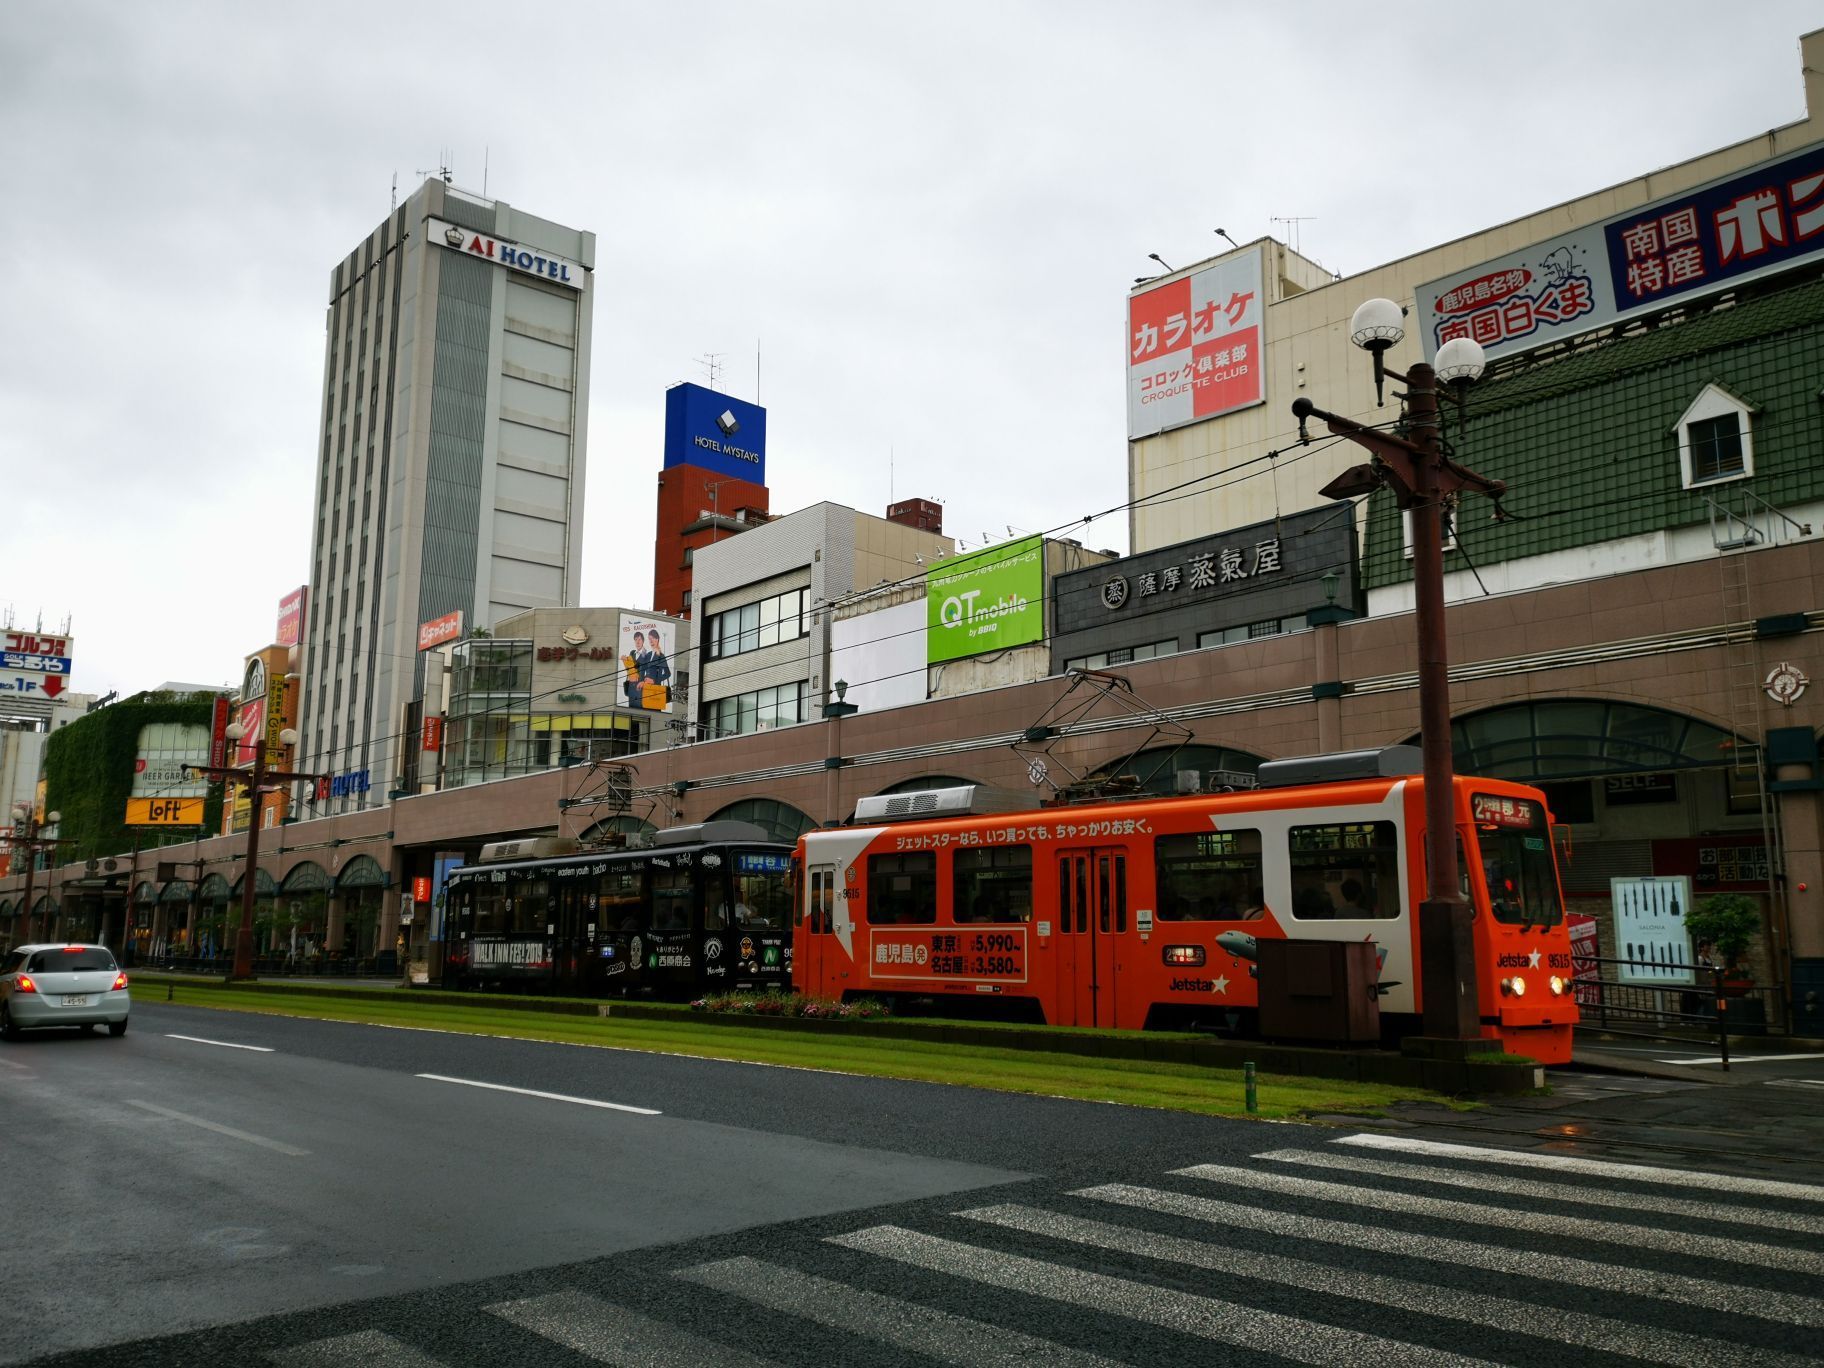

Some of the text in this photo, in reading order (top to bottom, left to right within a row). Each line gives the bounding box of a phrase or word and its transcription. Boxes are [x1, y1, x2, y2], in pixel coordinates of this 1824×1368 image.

[1622, 207, 1697, 261] 南国
[468, 235, 571, 282] AI HOTEL
[1628, 245, 1704, 297] 特産
[1441, 269, 1526, 314] 鹿児島名物
[1133, 290, 1254, 358] カラオケ
[1141, 343, 1248, 391] コロッケ倶楽部
[1141, 365, 1248, 405] CROQUETTE CLUB
[694, 435, 760, 464] HOTEL MYSTAYS
[968, 629, 978, 638] by
[3, 656, 64, 672] つるや
[15, 677, 37, 692] 1F
[1474, 797, 1484, 819] 2
[896, 818, 1154, 850] ジェットスターなら、いつ買っても、ちゃっかりお安く。
[474, 943, 494, 963] WALK
[526, 943, 543, 963] 2019
[931, 934, 957, 952] 東京
[931, 955, 964, 974] 名古屋
[1497, 952, 1530, 968] Jetstar
[1548, 953, 1570, 969] 9515
[1169, 976, 1213, 993] Jetstar
